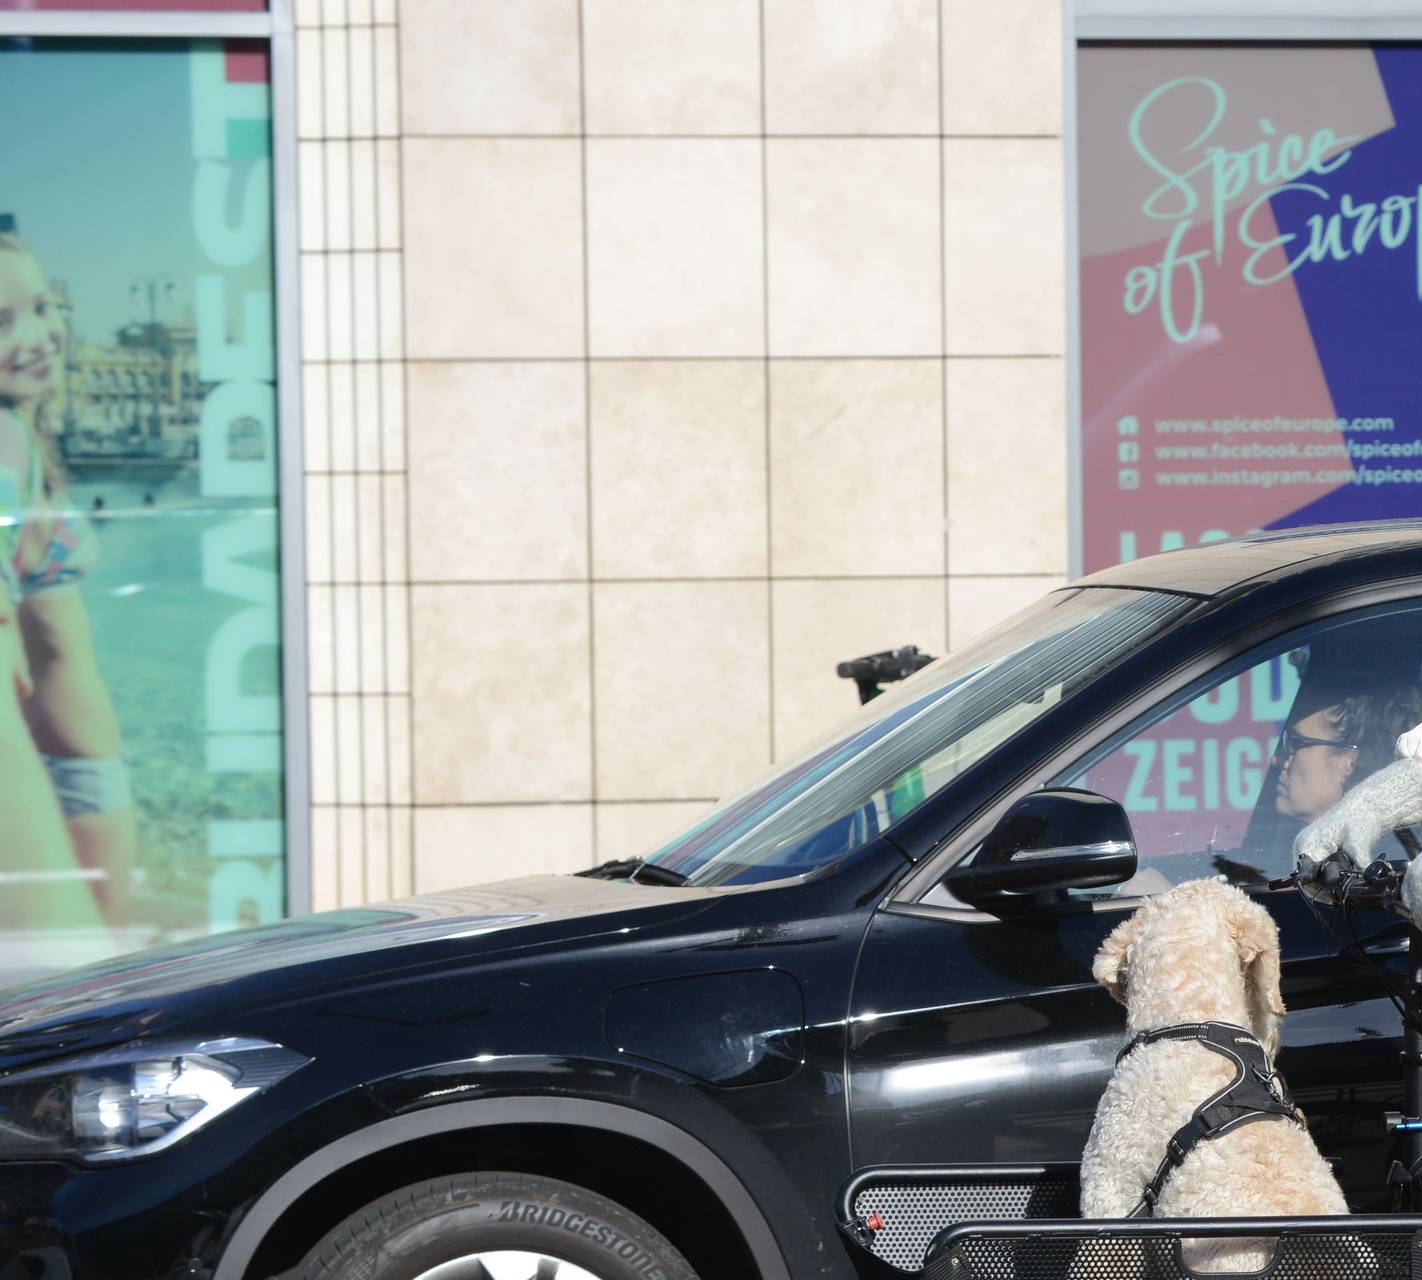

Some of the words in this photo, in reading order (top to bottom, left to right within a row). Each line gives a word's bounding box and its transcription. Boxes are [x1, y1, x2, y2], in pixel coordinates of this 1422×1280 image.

[1128, 75, 1361, 267] Spice
[1124, 218, 1211, 343] of
[1155, 415, 1394, 435] www.spiceofeurope.com
[1123, 737, 1280, 812] ZEIG
